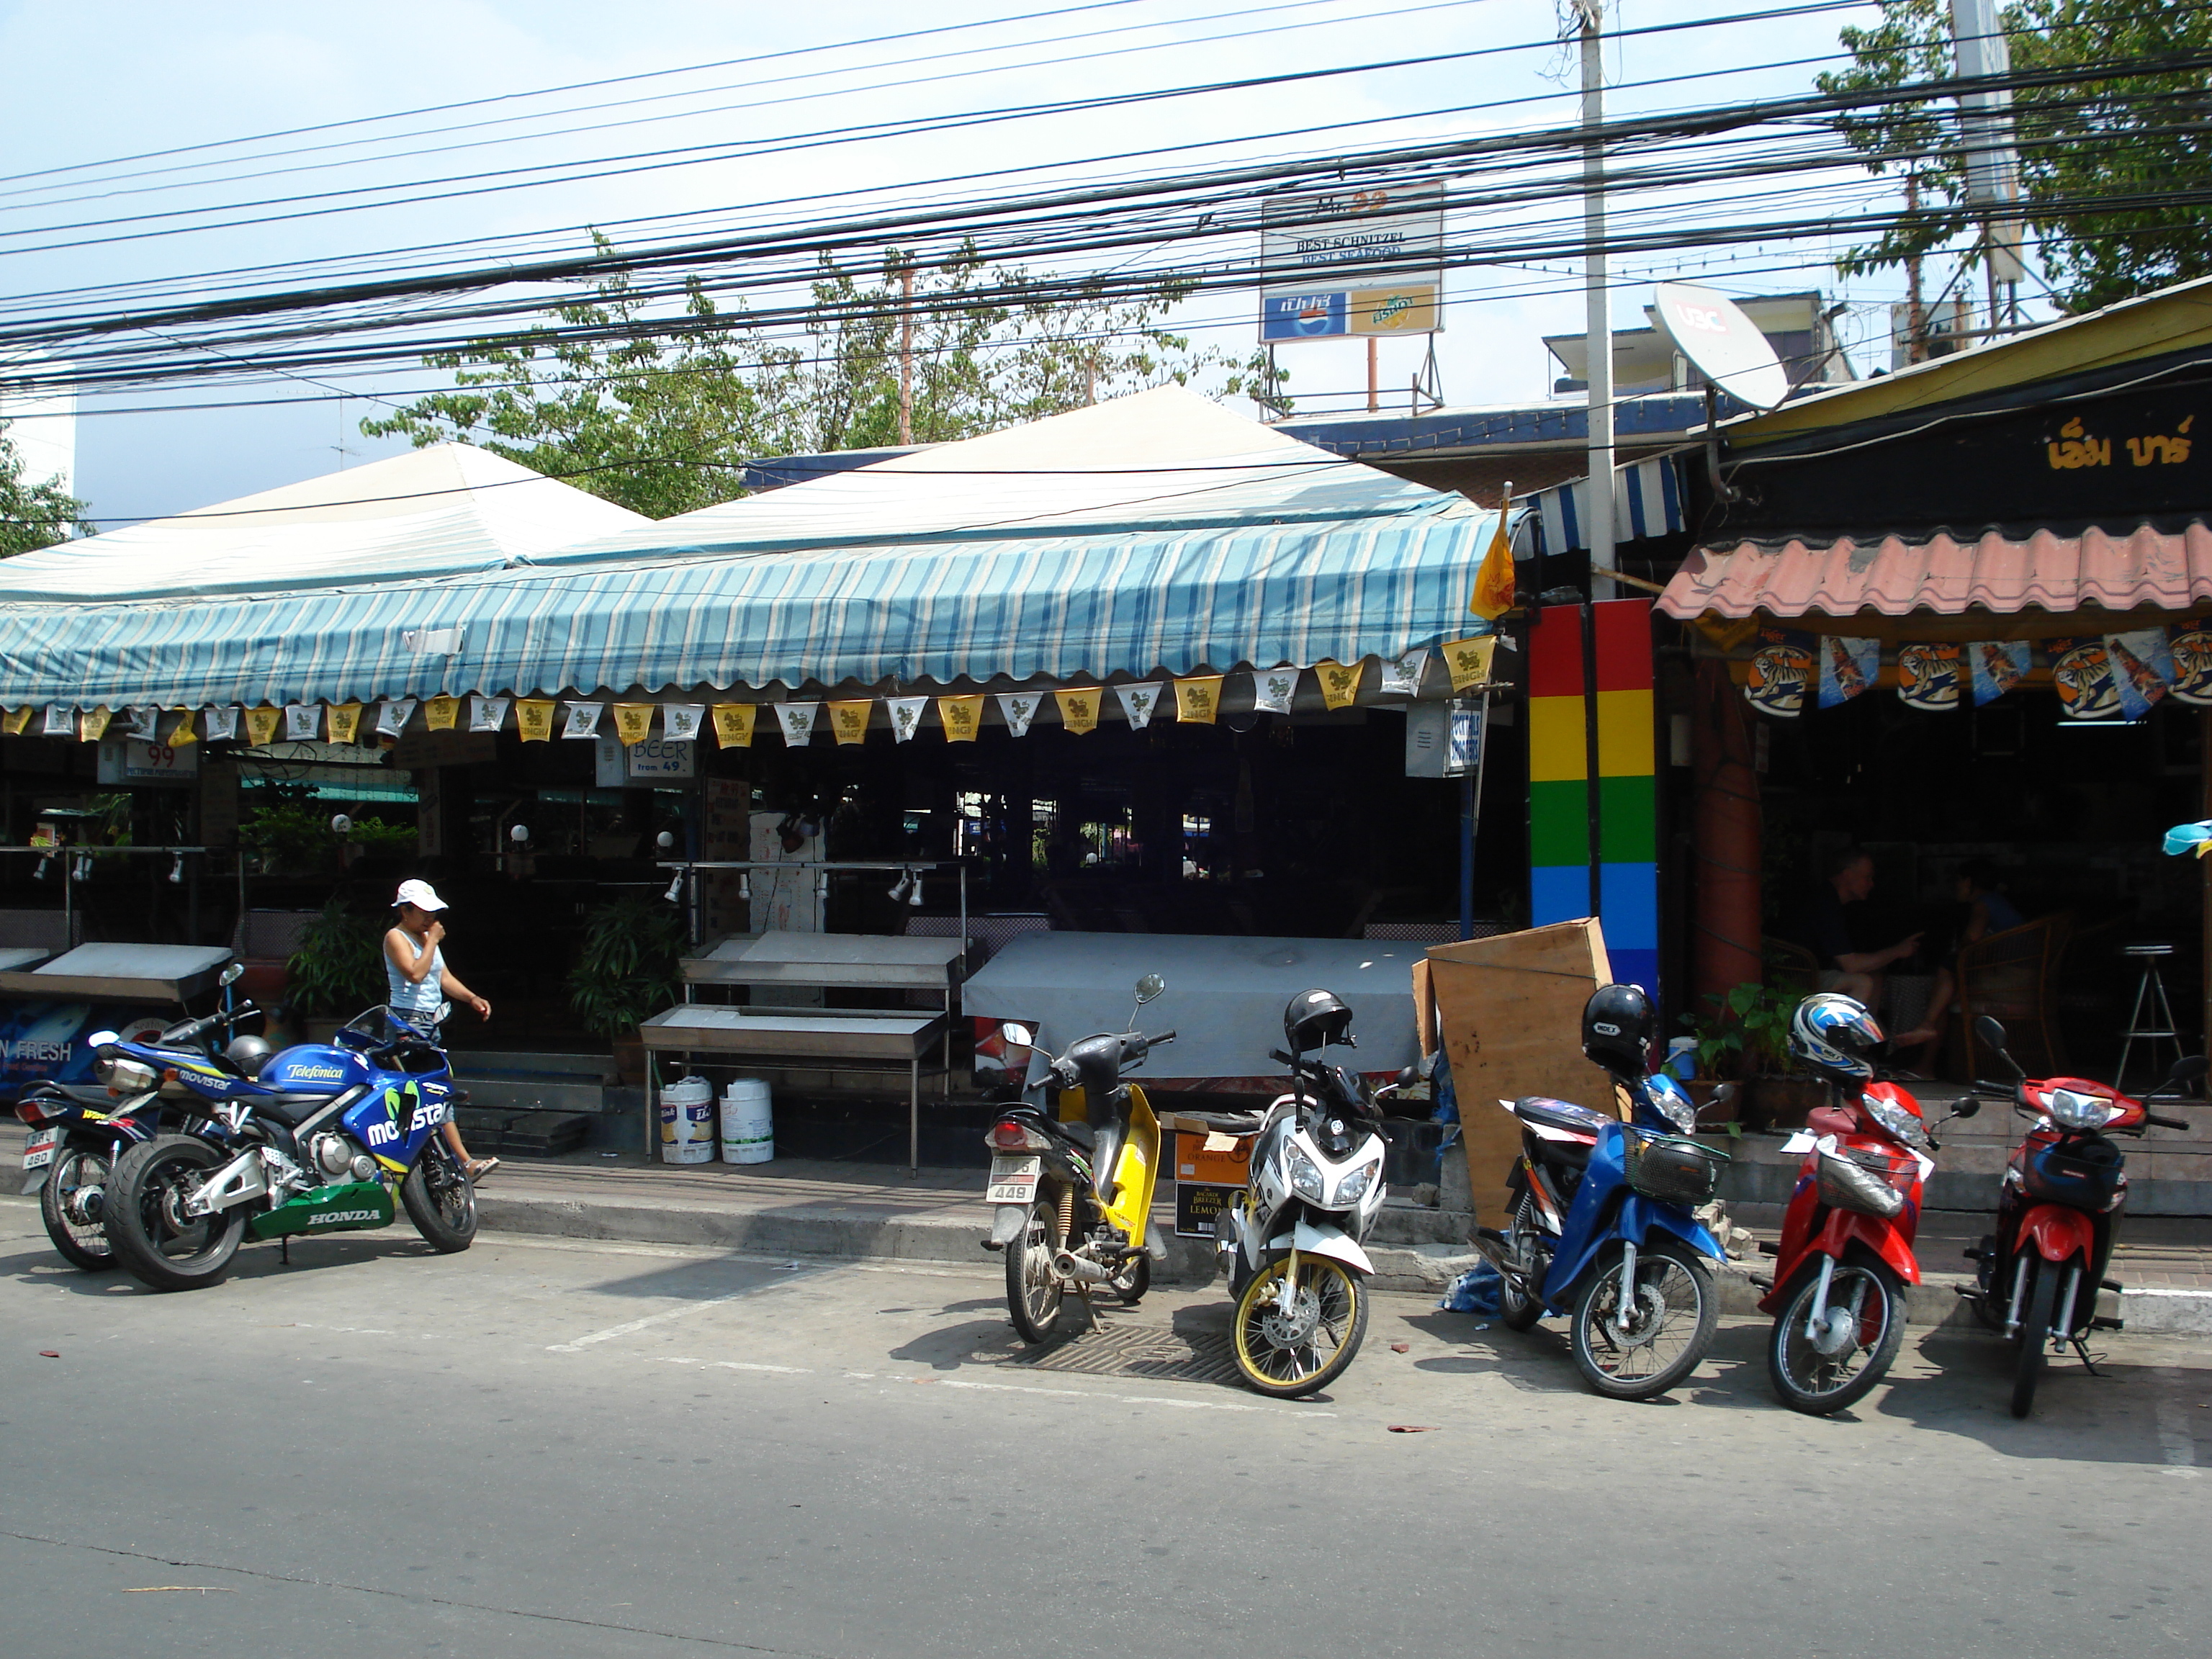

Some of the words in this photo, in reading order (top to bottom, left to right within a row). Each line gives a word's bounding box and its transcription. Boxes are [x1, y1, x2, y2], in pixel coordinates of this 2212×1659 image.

[1297, 238, 1330, 252] BEST
[1334, 232, 1406, 247] SCHNITZEL
[1302, 252, 1335, 264] BEST
[1339, 247, 1403, 260] SEAFOOD
[1677, 304, 1727, 332] UBC
[2049, 416, 2111, 469] เอ็ม
[2126, 415, 2195, 467] บาร์
[148, 745, 175, 768] 99
[634, 739, 687, 760] BEER
[16, 1040, 72, 1062] FRESH
[1187, 1152, 1226, 1162] ORANGE
[994, 1187, 1027, 1198] 449
[1193, 1196, 1222, 1206] BREEZER
[307, 1209, 381, 1226] HONDA
